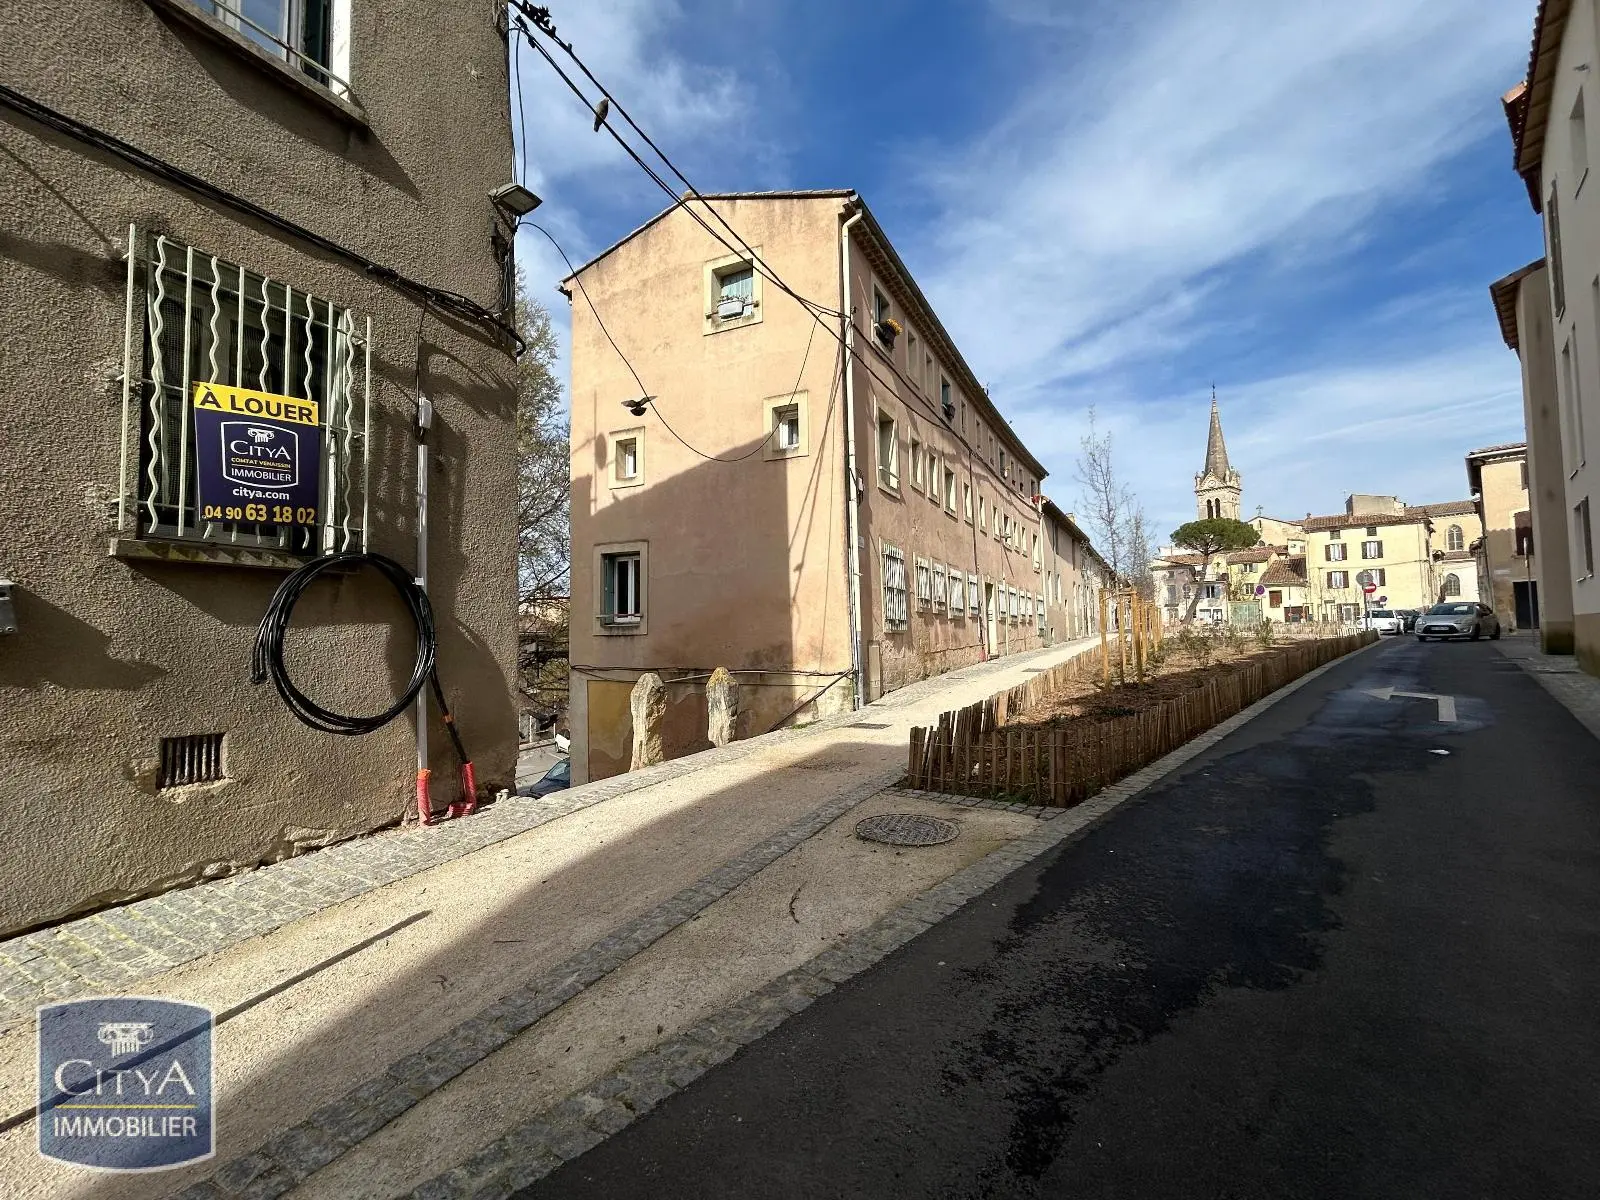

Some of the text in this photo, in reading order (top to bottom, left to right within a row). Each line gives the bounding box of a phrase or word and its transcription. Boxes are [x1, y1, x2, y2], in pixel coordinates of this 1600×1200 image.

[200, 385, 313, 423] À LOUER
[230, 440, 291, 460] CITYA
[231, 457, 291, 469] COMTAT VENAISSIN
[231, 468, 292, 482] IMMOBILIER
[232, 486, 290, 500] citya.com
[204, 503, 315, 524] 04 90 63 18 02
